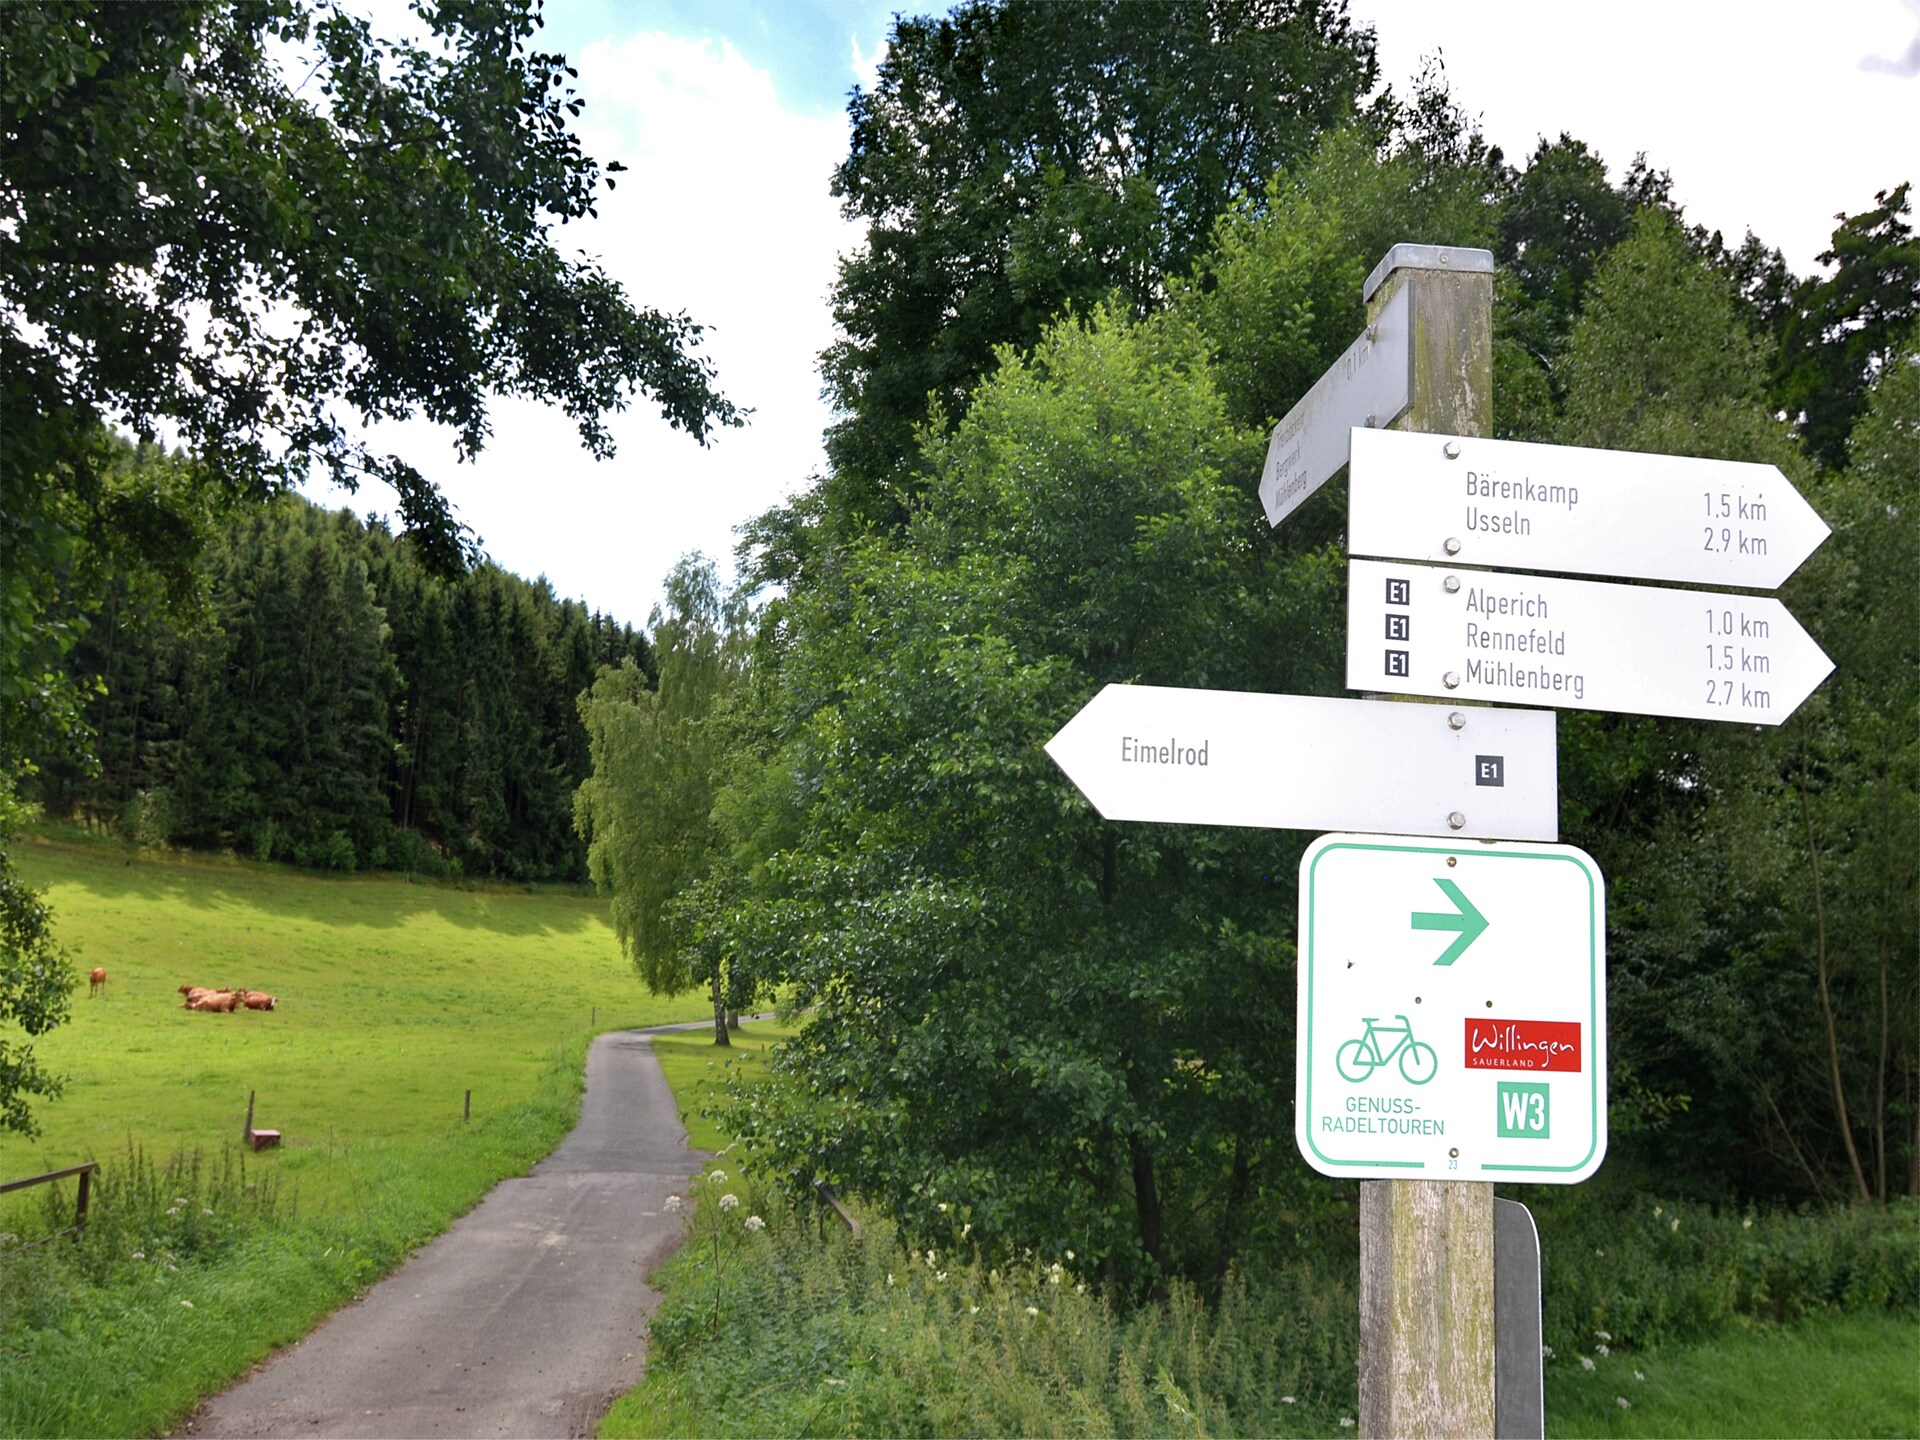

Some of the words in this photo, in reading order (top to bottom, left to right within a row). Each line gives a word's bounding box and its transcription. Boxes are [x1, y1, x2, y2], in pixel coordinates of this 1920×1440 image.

[1466, 471, 1578, 511] Bärenkamp
[1704, 492, 1731, 518] 1.5
[1738, 495, 1767, 521] km
[1466, 506, 1530, 536] Usseln
[1704, 527, 1731, 553] 2.9
[1739, 529, 1767, 556] km
[1390, 582, 1408, 603] E1
[1466, 587, 1548, 620] Alperich
[1706, 609, 1733, 636] 1.0
[1741, 612, 1769, 638] km
[1389, 617, 1407, 639] E1
[1467, 622, 1565, 656] Rennefeld
[1706, 644, 1733, 671] 1.5
[1742, 647, 1770, 673] km
[1389, 653, 1407, 675] E1
[1466, 658, 1584, 700] Mühlenberg
[1706, 680, 1734, 706] 2.7
[1742, 682, 1770, 709] km
[1122, 736, 1208, 766] Eimelrod
[1481, 762, 1498, 779] E1
[1472, 1024, 1575, 1068] Willingen
[1472, 1057, 1534, 1068] SAUERLAND
[1322, 1116, 1445, 1136] RADELTOUREN
[1346, 1096, 1421, 1115] GENUSS-
[1502, 1092, 1545, 1131] W3
